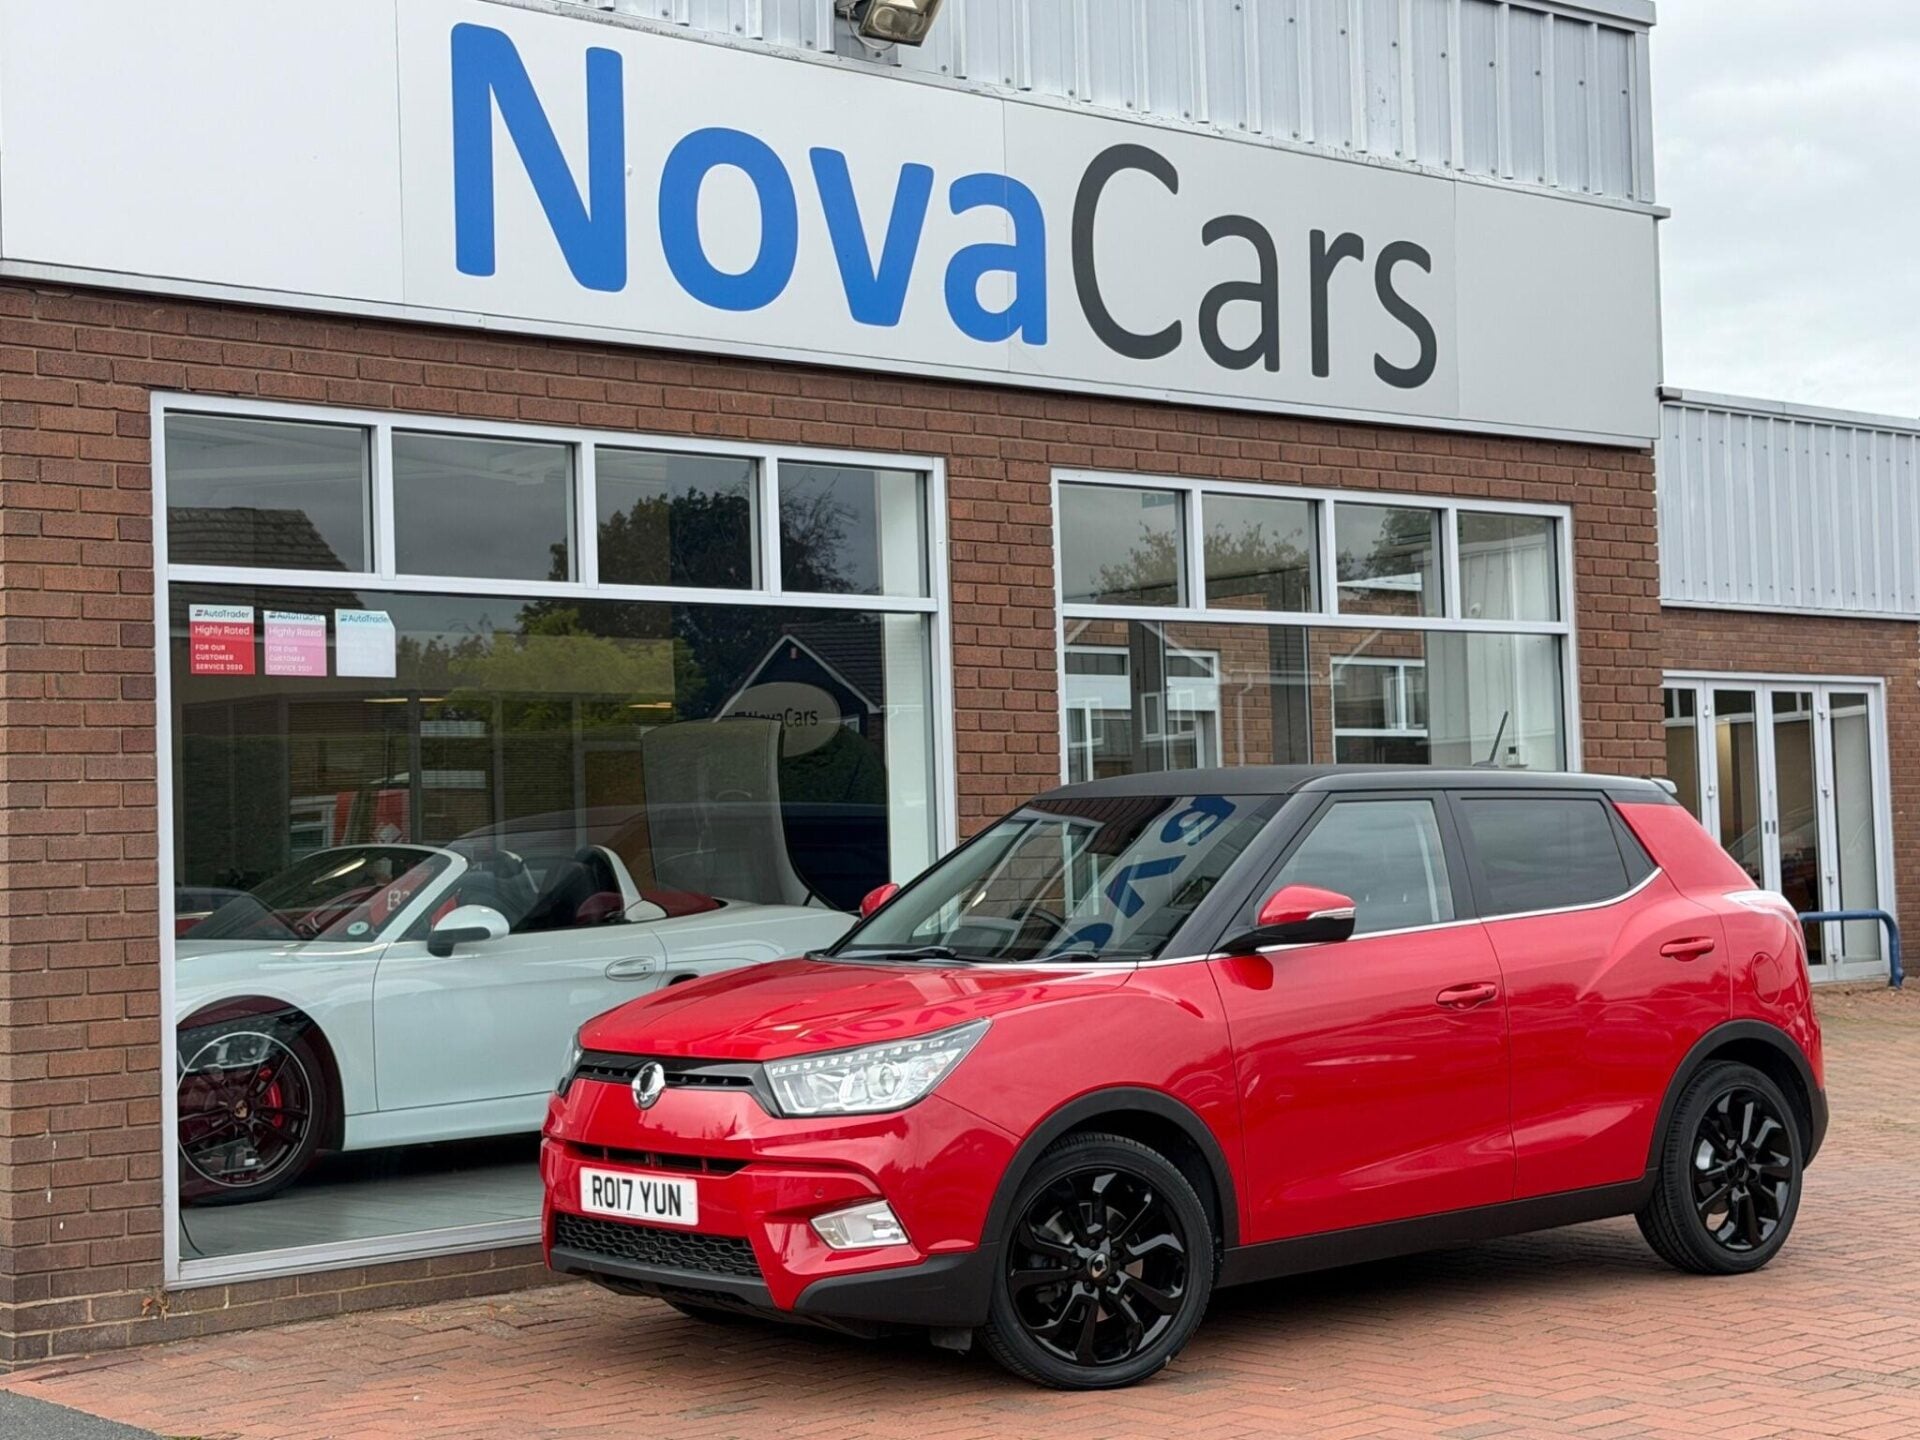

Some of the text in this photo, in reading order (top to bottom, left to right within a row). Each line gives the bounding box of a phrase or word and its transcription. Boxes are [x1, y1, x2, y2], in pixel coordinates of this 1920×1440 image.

[450, 22, 1437, 389] NovaCars
[204, 609, 249, 619] AutoTrader
[348, 614, 389, 623] AutoTrade
[194, 625, 250, 637] Highly Rated
[268, 628, 322, 638] Highly Rated
[195, 653, 234, 661] CUSTOMER
[196, 663, 224, 671] SERVICE
[592, 1175, 682, 1217] RO17 YUN
